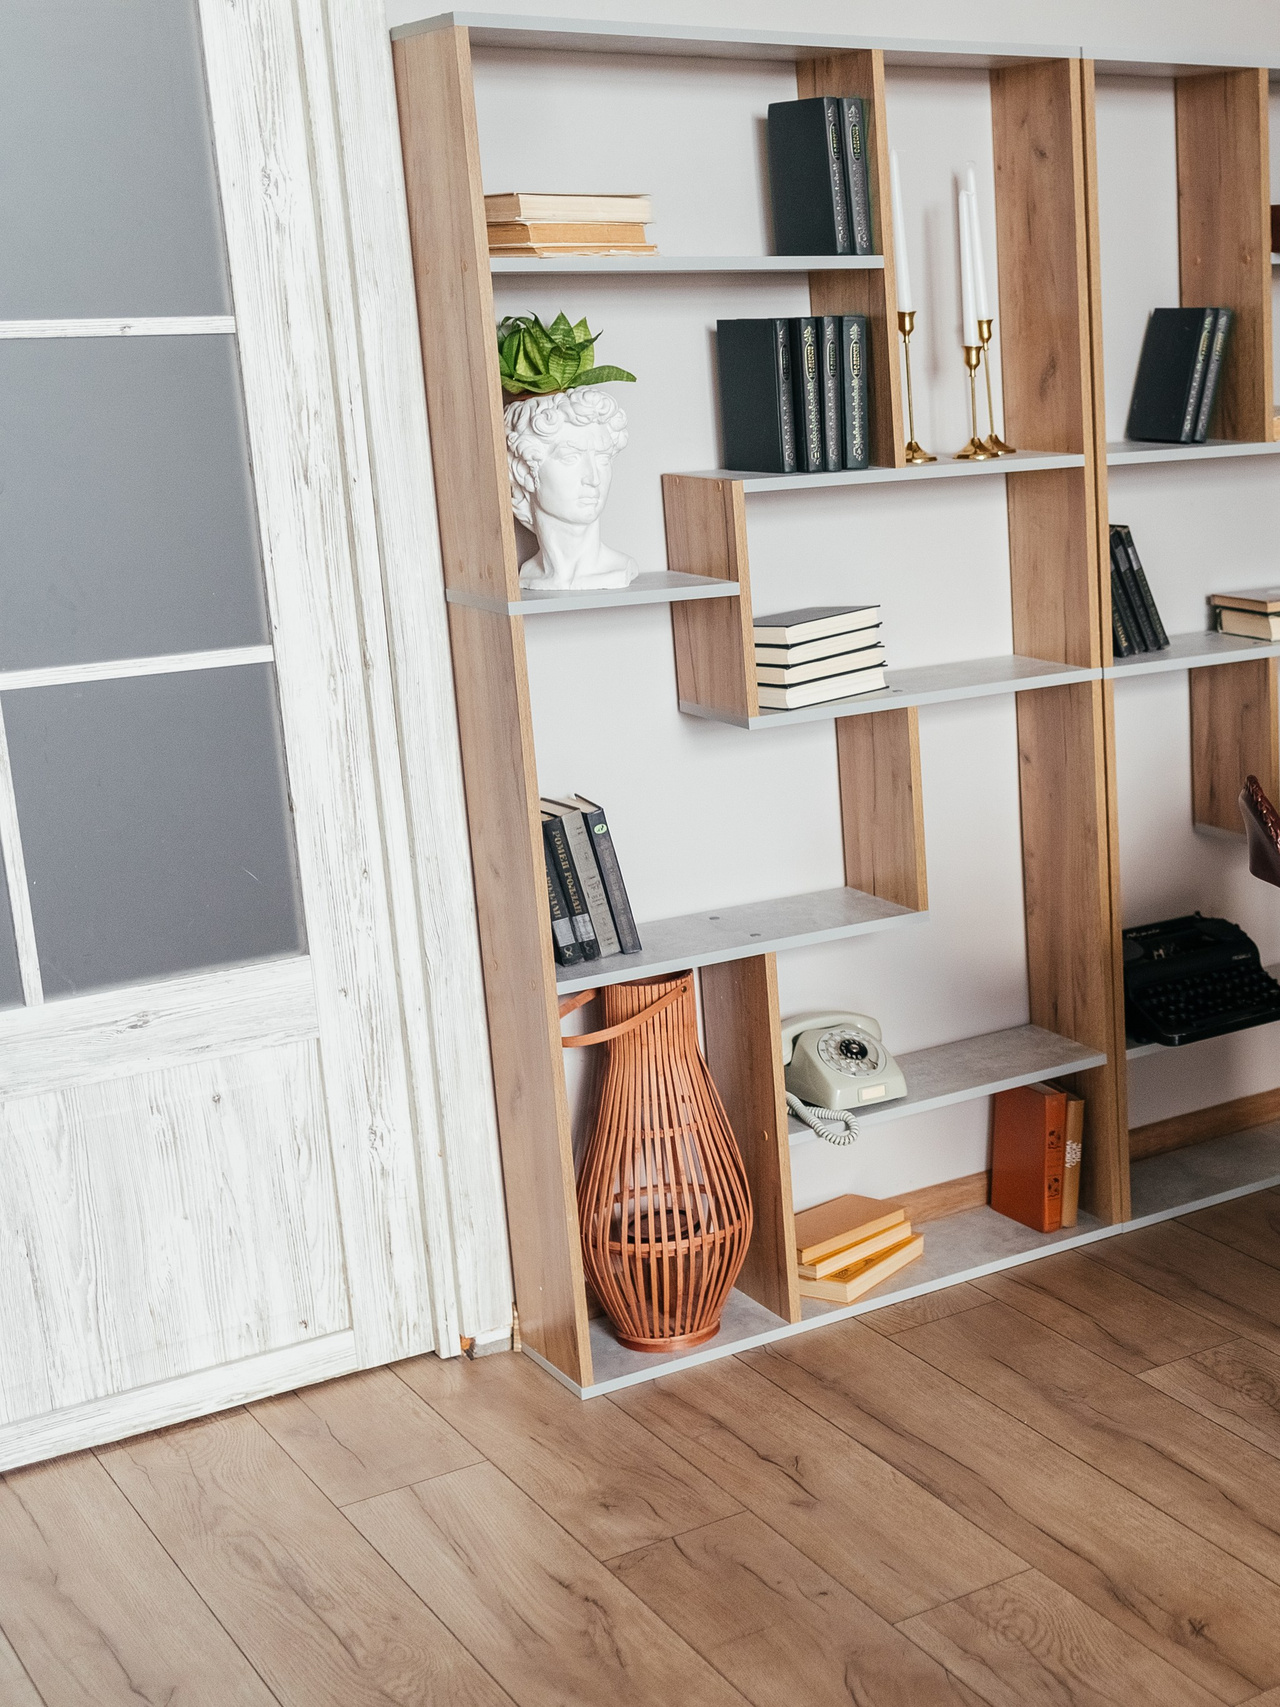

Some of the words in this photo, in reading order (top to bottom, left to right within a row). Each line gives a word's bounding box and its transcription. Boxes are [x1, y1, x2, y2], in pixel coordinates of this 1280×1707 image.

[552, 830, 570, 869] РОМЕН
[564, 871, 582, 914] РОЛЛАН
[563, 945, 574, 958] 8
